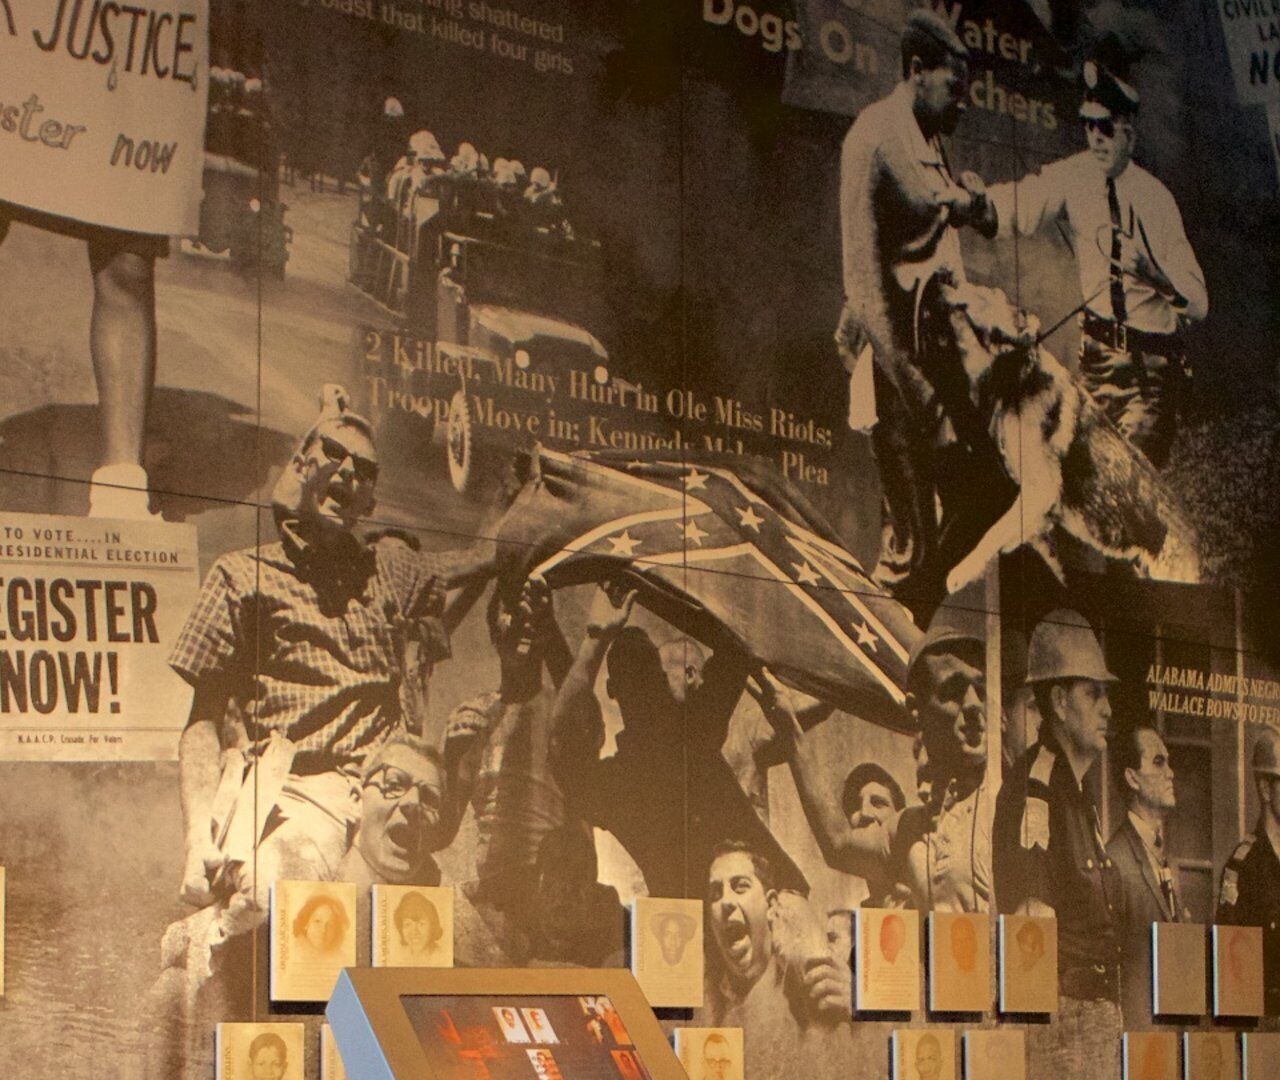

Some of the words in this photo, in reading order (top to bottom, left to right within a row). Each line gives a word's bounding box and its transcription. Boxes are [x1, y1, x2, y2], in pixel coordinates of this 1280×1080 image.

[33, 0, 198, 84] JUSTICE
[382, 5, 425, 34] that
[433, 17, 484, 49] killed
[492, 33, 527, 61] four
[533, 50, 574, 75] girls
[471, 2, 564, 43] shattered
[703, 0, 803, 52] Dogs
[822, 20, 880, 75] On
[110, 133, 178, 175] now
[365, 331, 382, 362] 2
[493, 354, 560, 404] Many
[636, 383, 659, 414] in
[666, 388, 708, 422] Ole
[715, 396, 765, 432] Miss
[770, 407, 833, 448] Riots;
[368, 376, 451, 428] Troop
[471, 394, 541, 434] Move
[782, 450, 829, 485] Plea
[4, 526, 24, 540] TO
[106, 549, 180, 574] ELECTION
[1146, 664, 1205, 691] ALABAMA
[1148, 691, 1204, 716] WALLACE
[1207, 698, 1241, 721] BOWS
